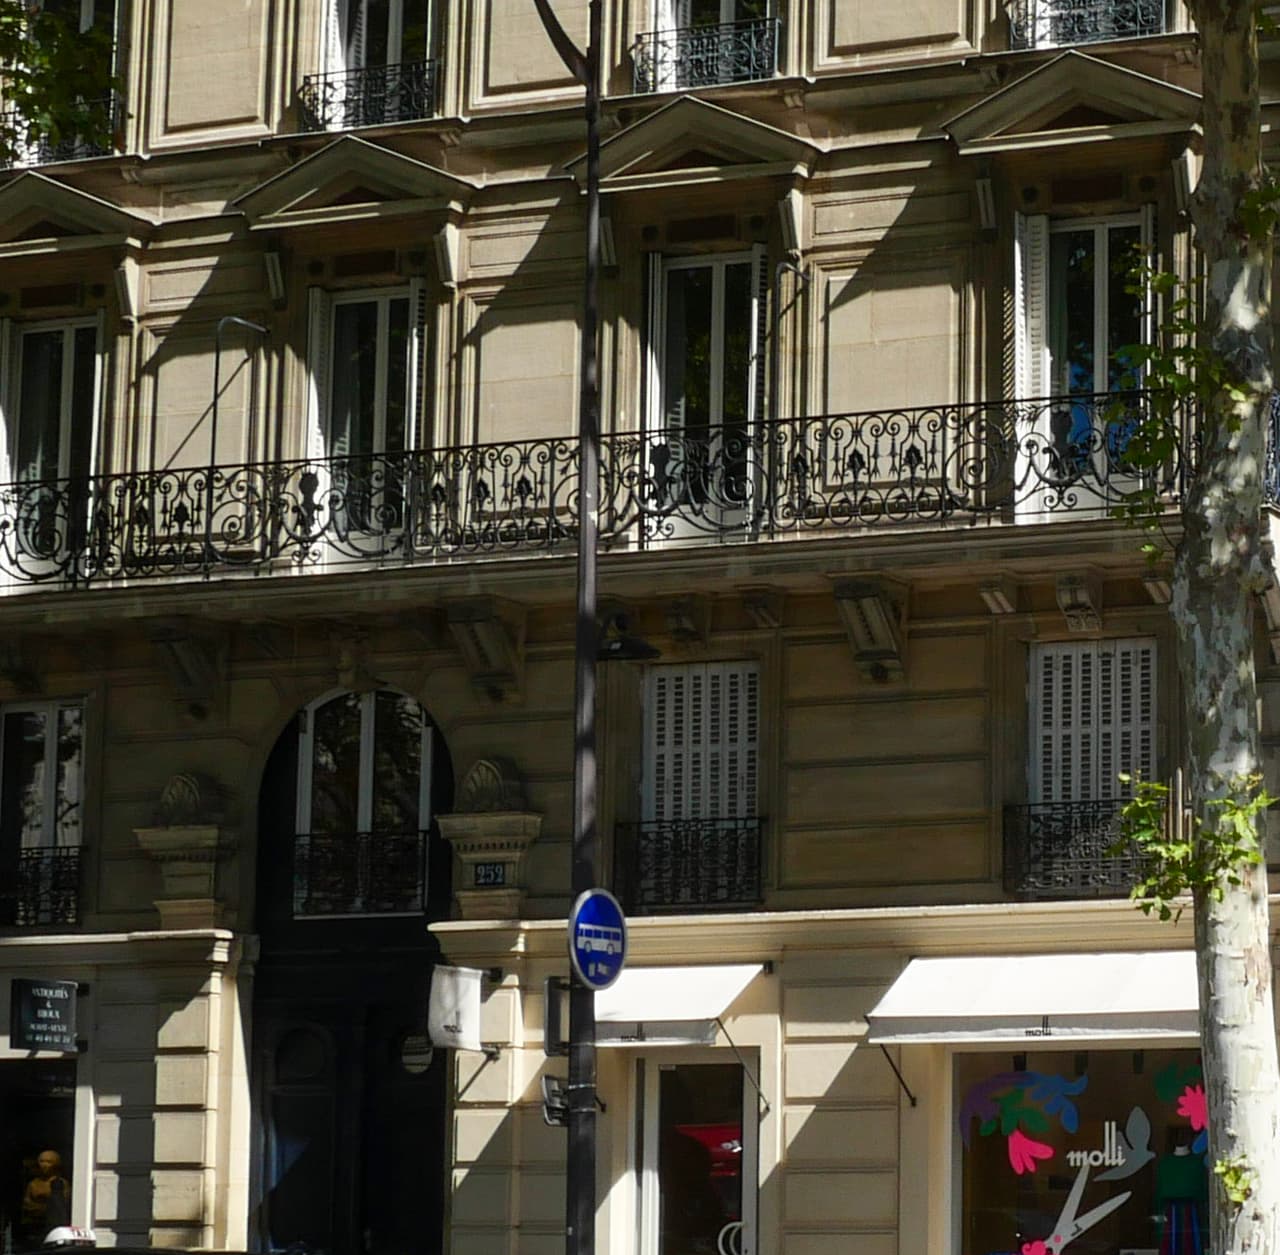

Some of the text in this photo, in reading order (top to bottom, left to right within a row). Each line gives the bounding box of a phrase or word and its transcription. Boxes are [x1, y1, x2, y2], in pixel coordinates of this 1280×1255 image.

[477, 864, 503, 883] 252
[1024, 1015, 1052, 1037] molli
[1066, 1121, 1126, 1167] molli
